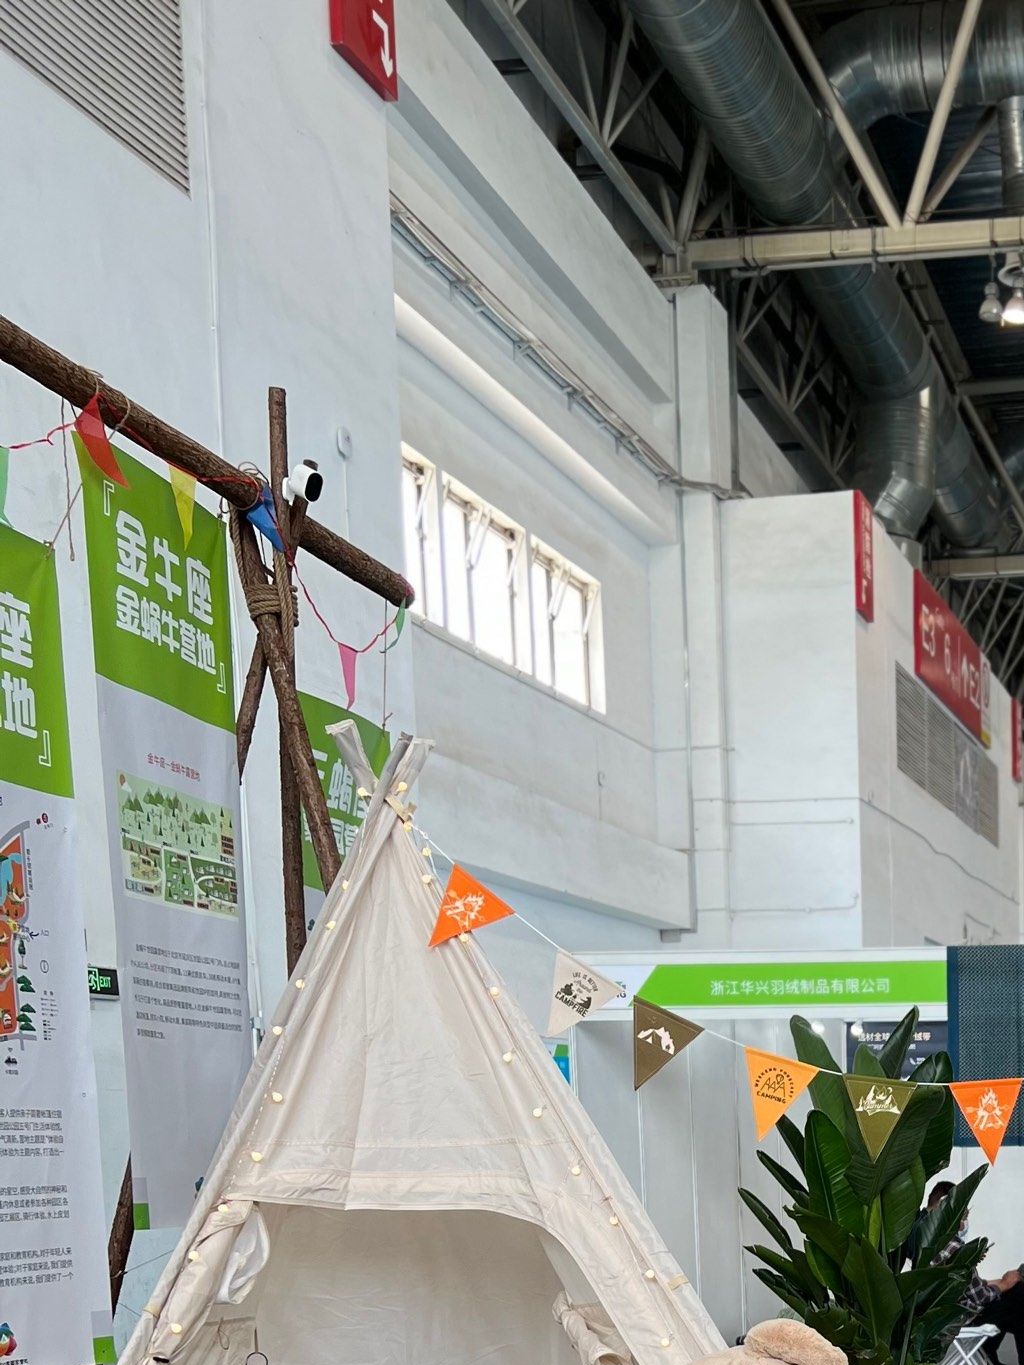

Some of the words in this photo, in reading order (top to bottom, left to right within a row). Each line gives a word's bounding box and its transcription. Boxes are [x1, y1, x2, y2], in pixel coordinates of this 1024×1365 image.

[115, 510, 213, 625] 金牛座
[115, 584, 217, 675] 金蜗牛营地
[99, 975, 112, 989] EXIT
[710, 978, 890, 996] 浙江华兴羽绒制品有限公司
[555, 991, 589, 1018] CAMPFIRE
[756, 1090, 787, 1104] CAMPING
